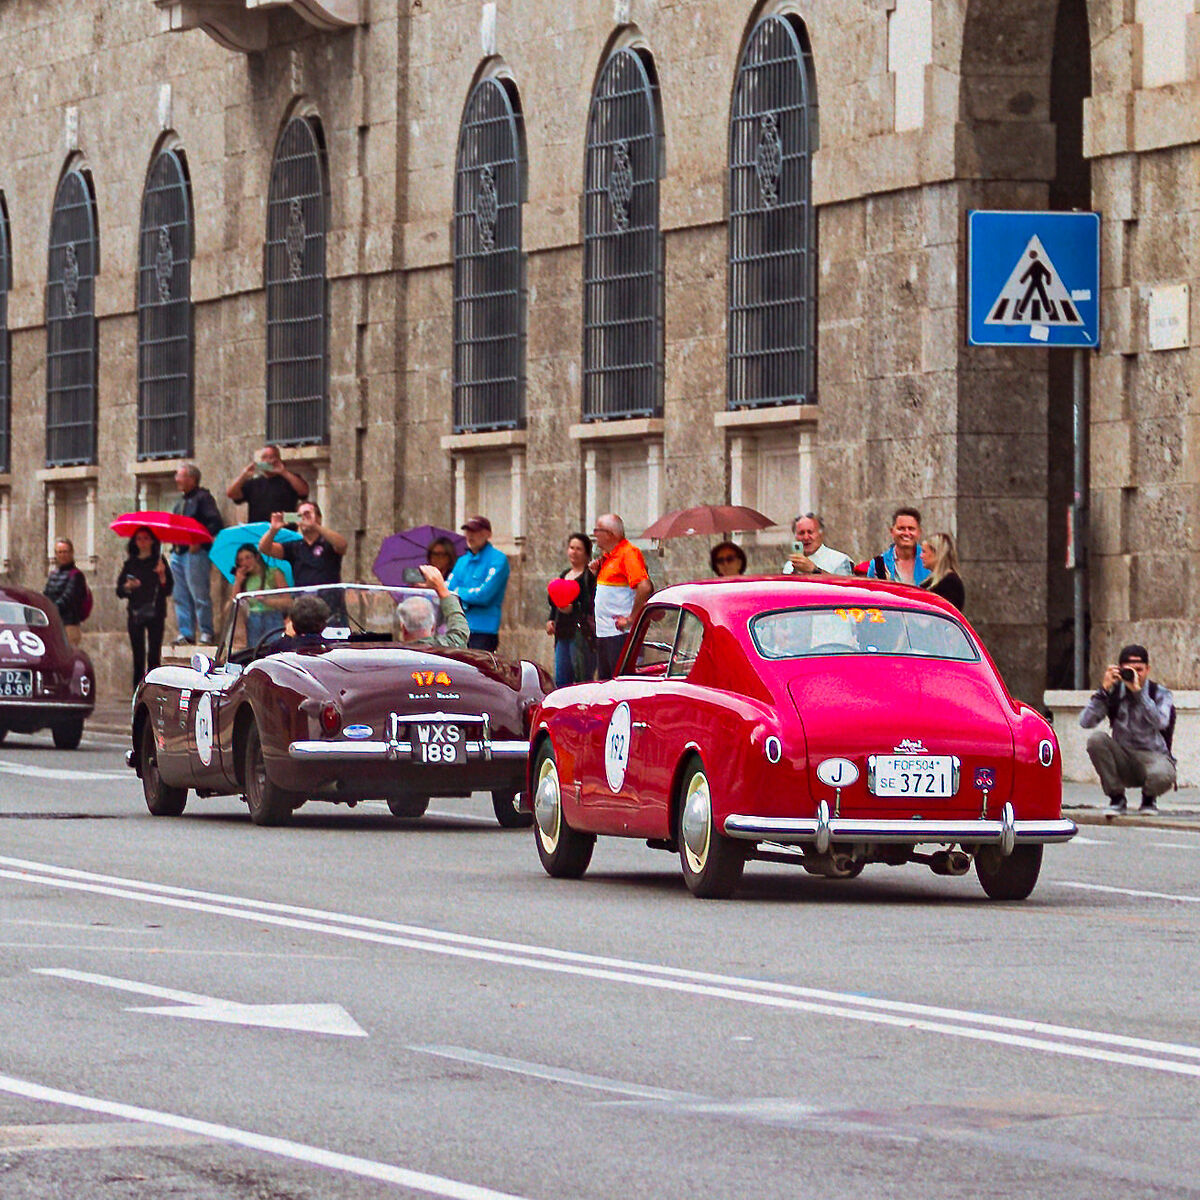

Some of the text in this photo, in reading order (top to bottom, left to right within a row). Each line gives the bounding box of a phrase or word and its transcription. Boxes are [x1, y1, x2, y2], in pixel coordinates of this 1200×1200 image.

[6, 672, 22, 683] DZ
[411, 671, 452, 686] 174
[417, 724, 460, 743] WXS
[422, 743, 456, 763] 189
[610, 733, 625, 761] 192
[831, 762, 843, 783] J
[880, 773, 946, 794] SE 3721
